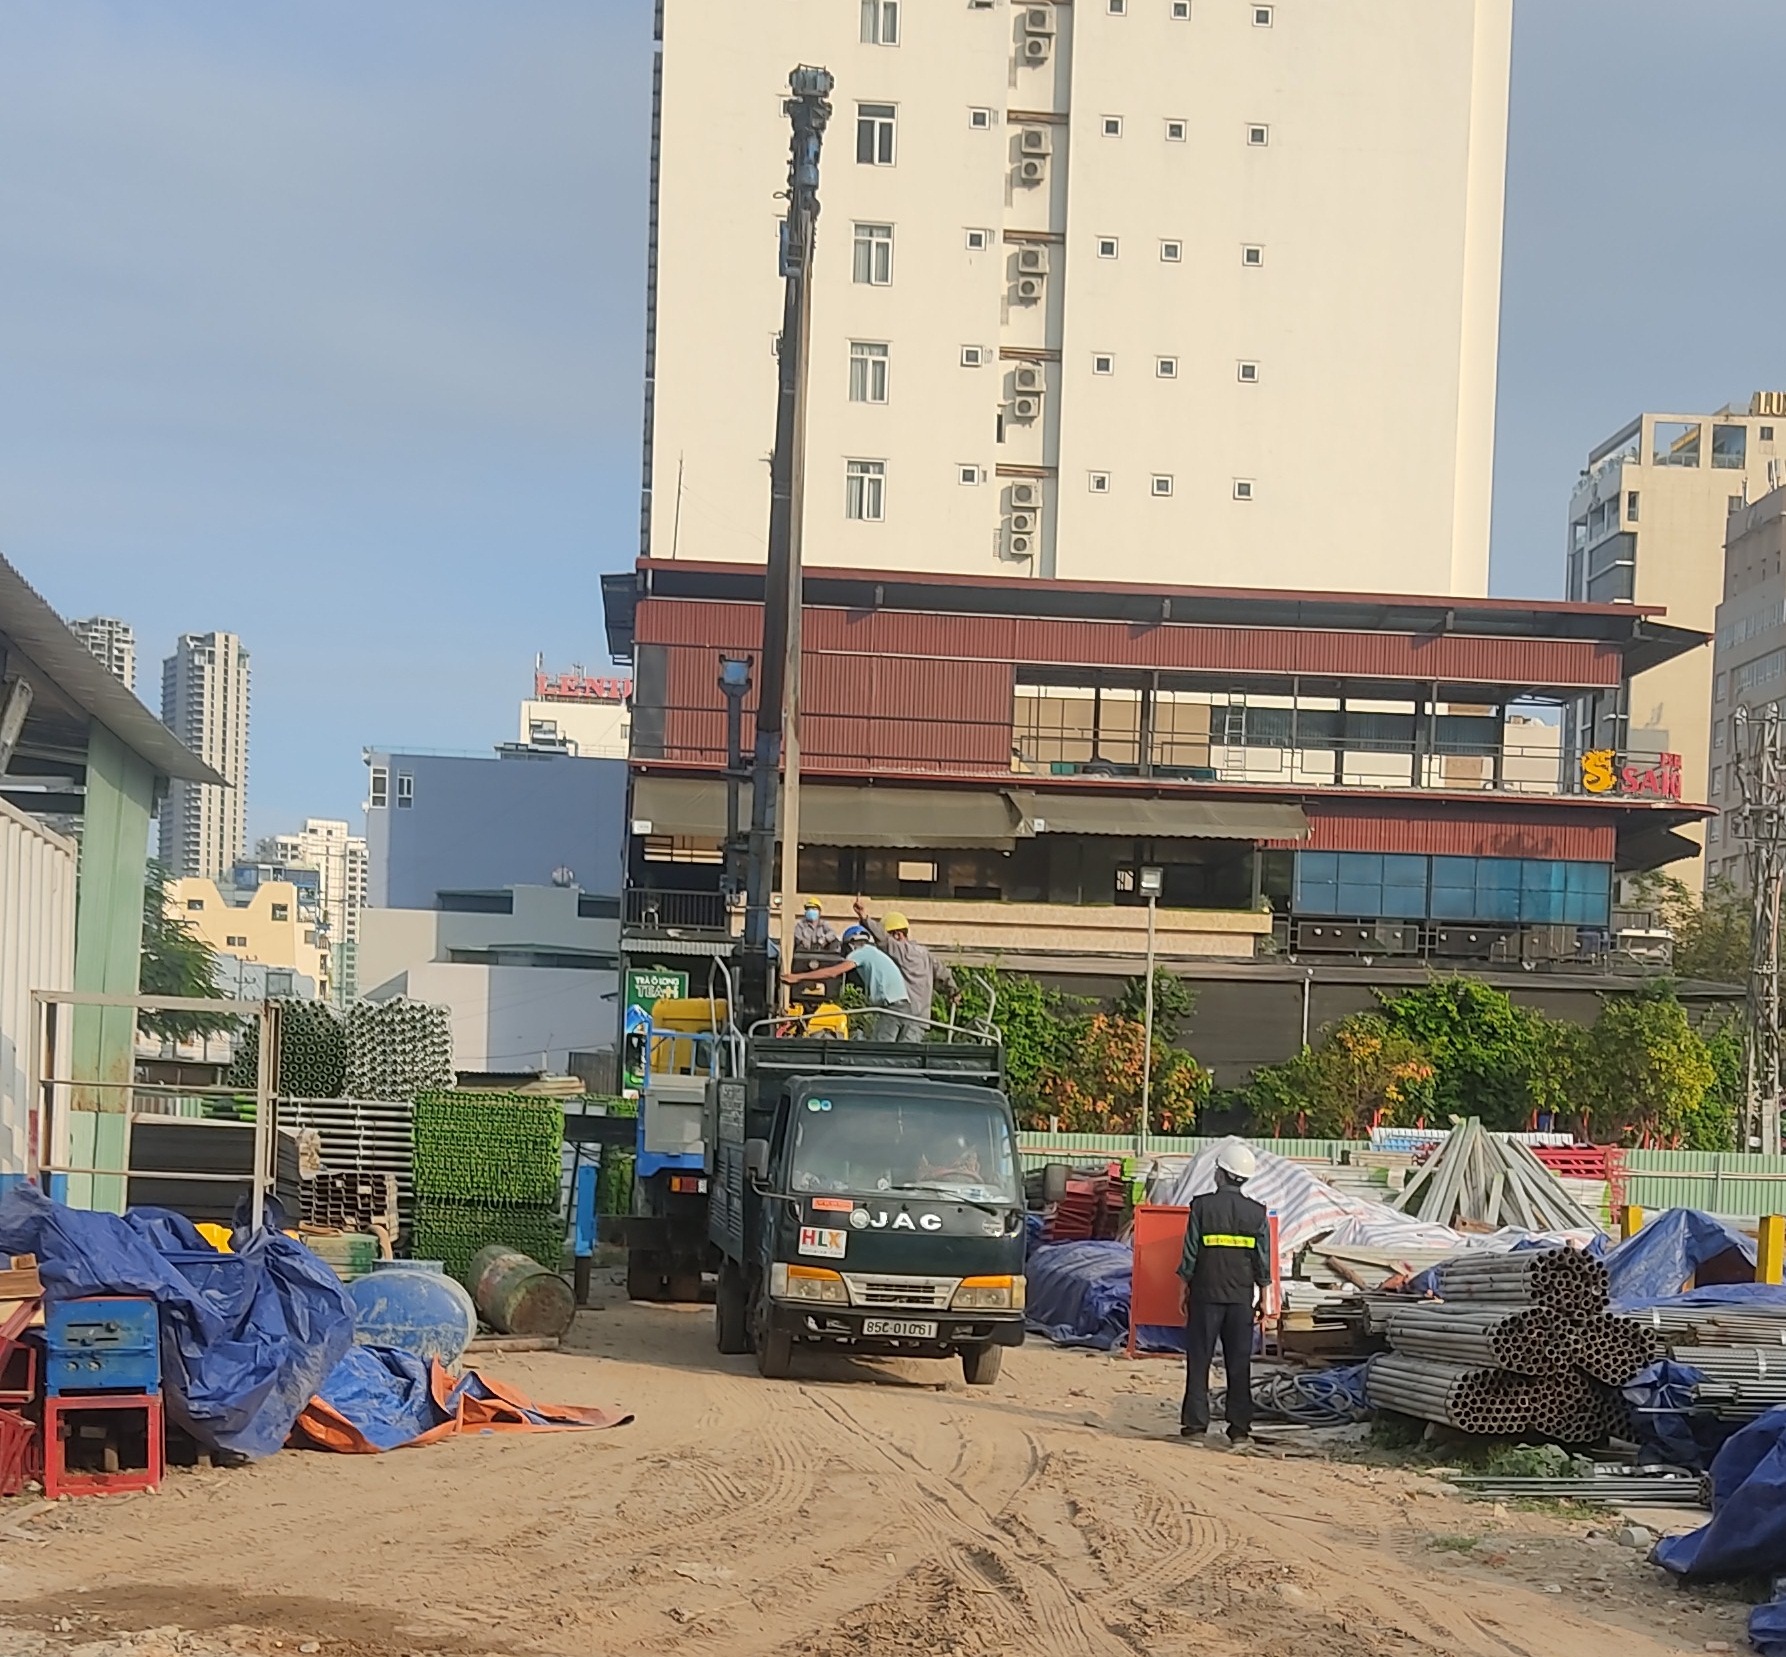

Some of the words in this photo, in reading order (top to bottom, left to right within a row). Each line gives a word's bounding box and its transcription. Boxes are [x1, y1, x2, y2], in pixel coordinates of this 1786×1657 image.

[1759, 391, 1786, 415] LU
[870, 1211, 942, 1231] JAC
[802, 1229, 841, 1249] HLX
